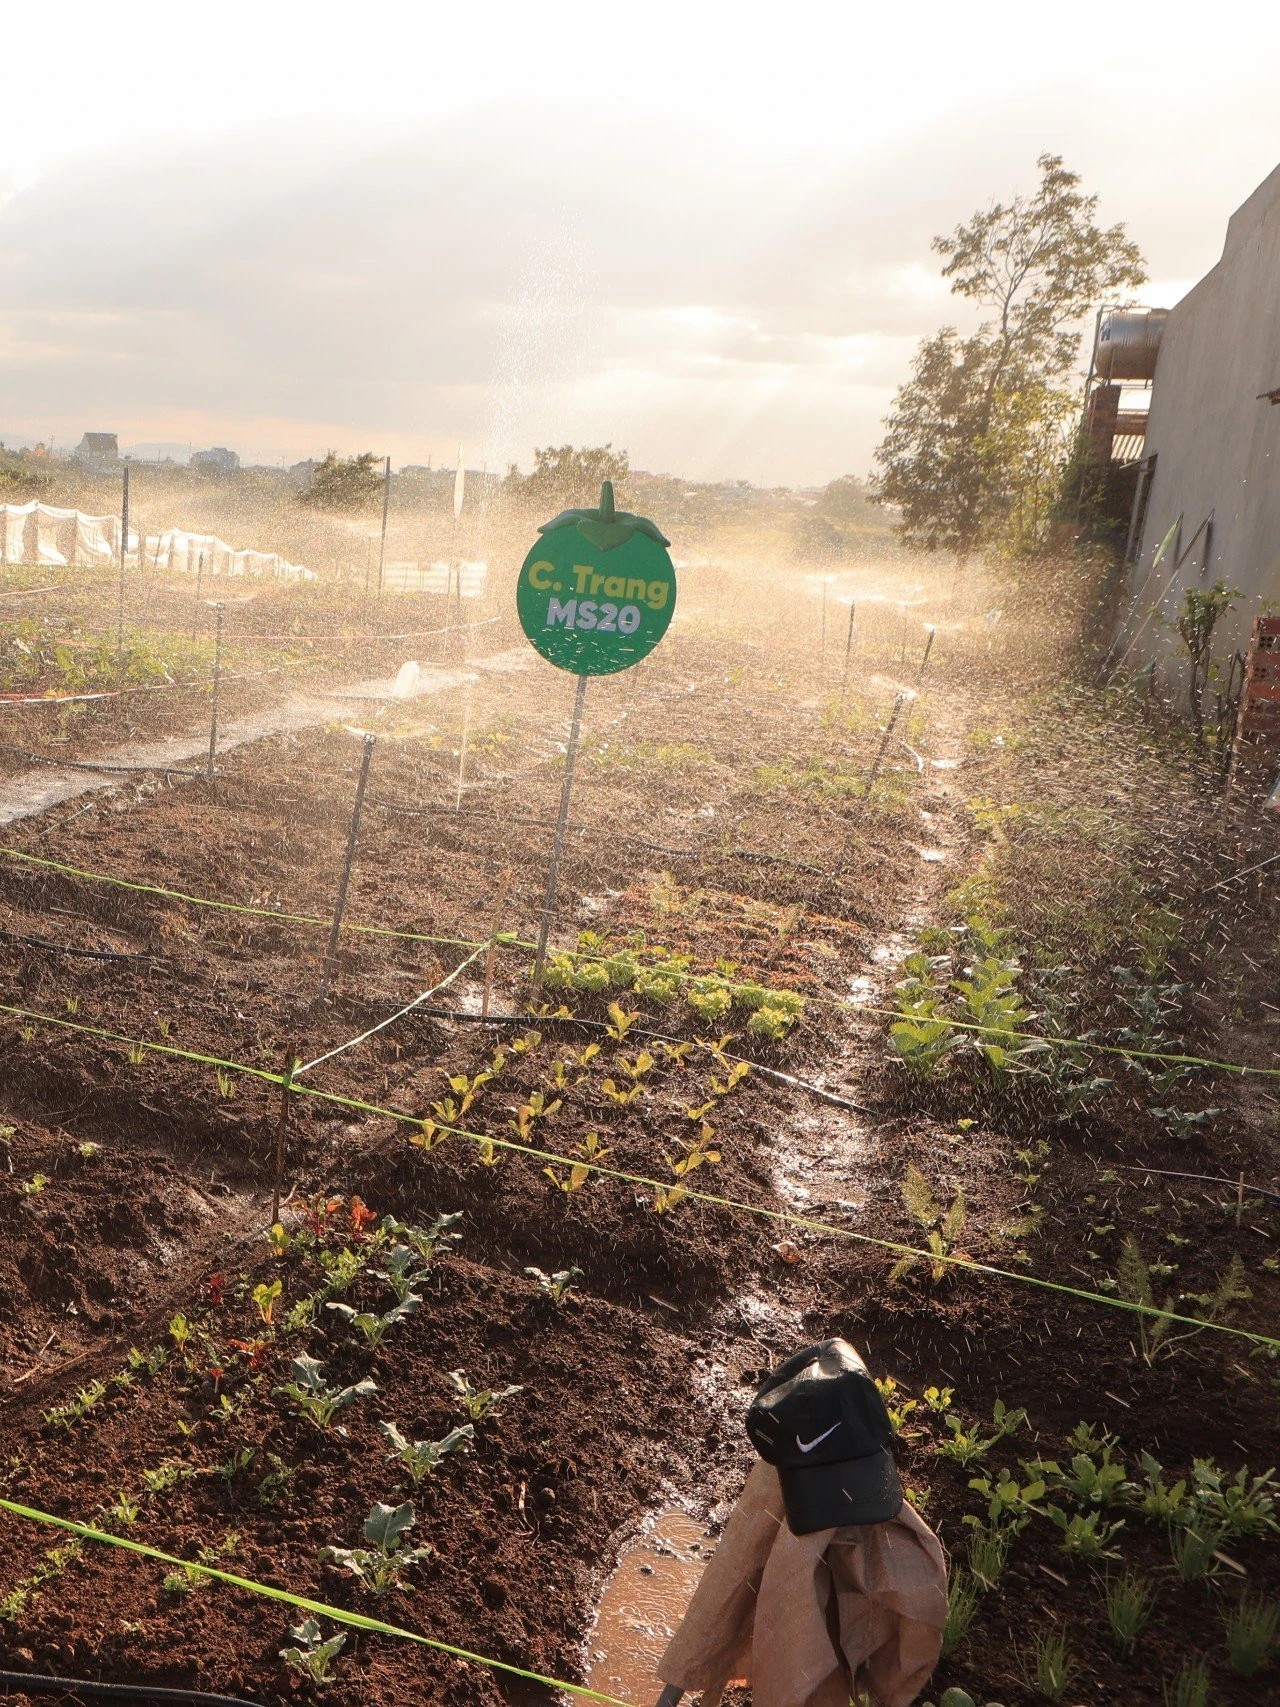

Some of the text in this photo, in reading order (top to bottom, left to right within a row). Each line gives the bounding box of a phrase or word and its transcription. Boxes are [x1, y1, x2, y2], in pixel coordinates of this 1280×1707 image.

[529, 560, 669, 610] C. Trang
[546, 597, 641, 634] MS20
